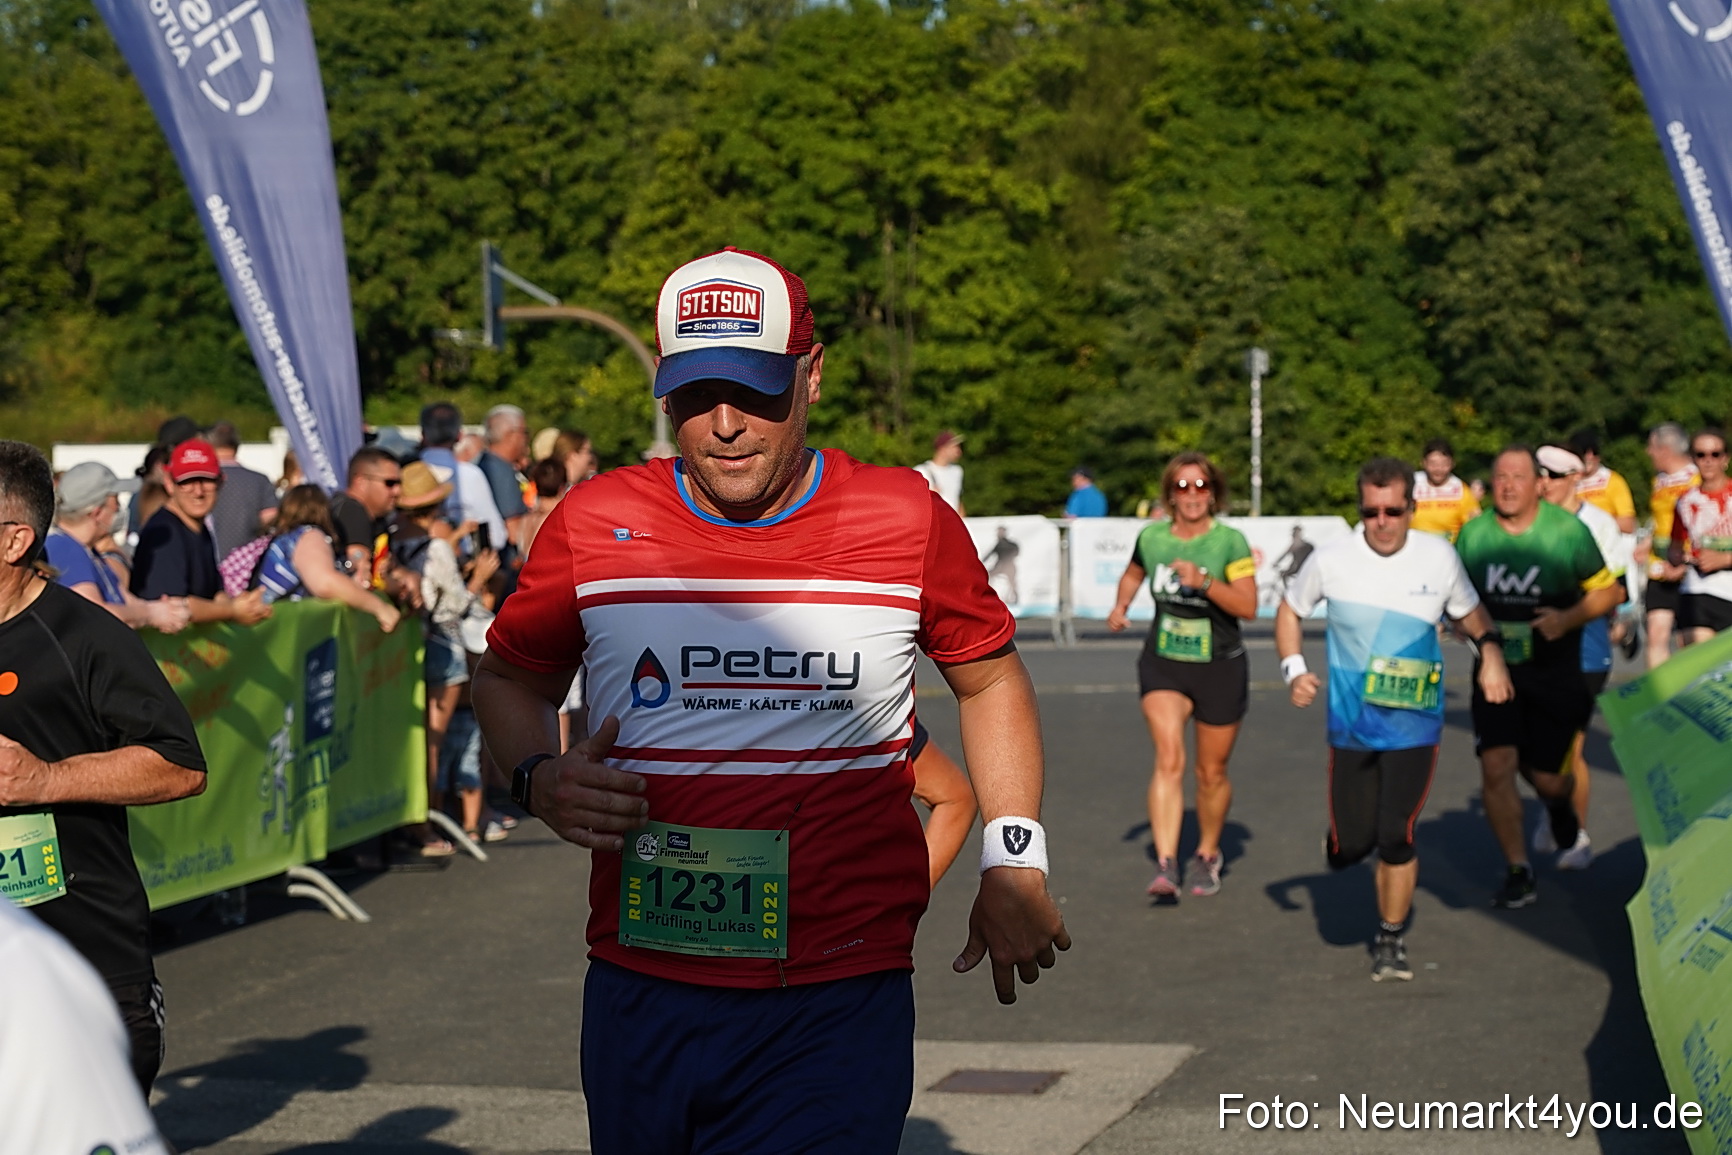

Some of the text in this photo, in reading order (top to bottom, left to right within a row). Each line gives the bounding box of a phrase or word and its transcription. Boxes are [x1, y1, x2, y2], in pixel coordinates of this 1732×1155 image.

[681, 290, 757, 317] STETSON
[681, 645, 861, 691] Petry
[682, 696, 854, 712] WÄRME KÄLTE KLIMA
[42, 843, 59, 886] 2022
[659, 847, 709, 860] Firmenlauf
[677, 858, 708, 866] neumarkt
[0, 874, 45, 893] einhard
[646, 866, 752, 915] 1231
[628, 876, 642, 921] RUN
[762, 881, 779, 940] 2022
[645, 910, 756, 933] Prüfling Lukas
